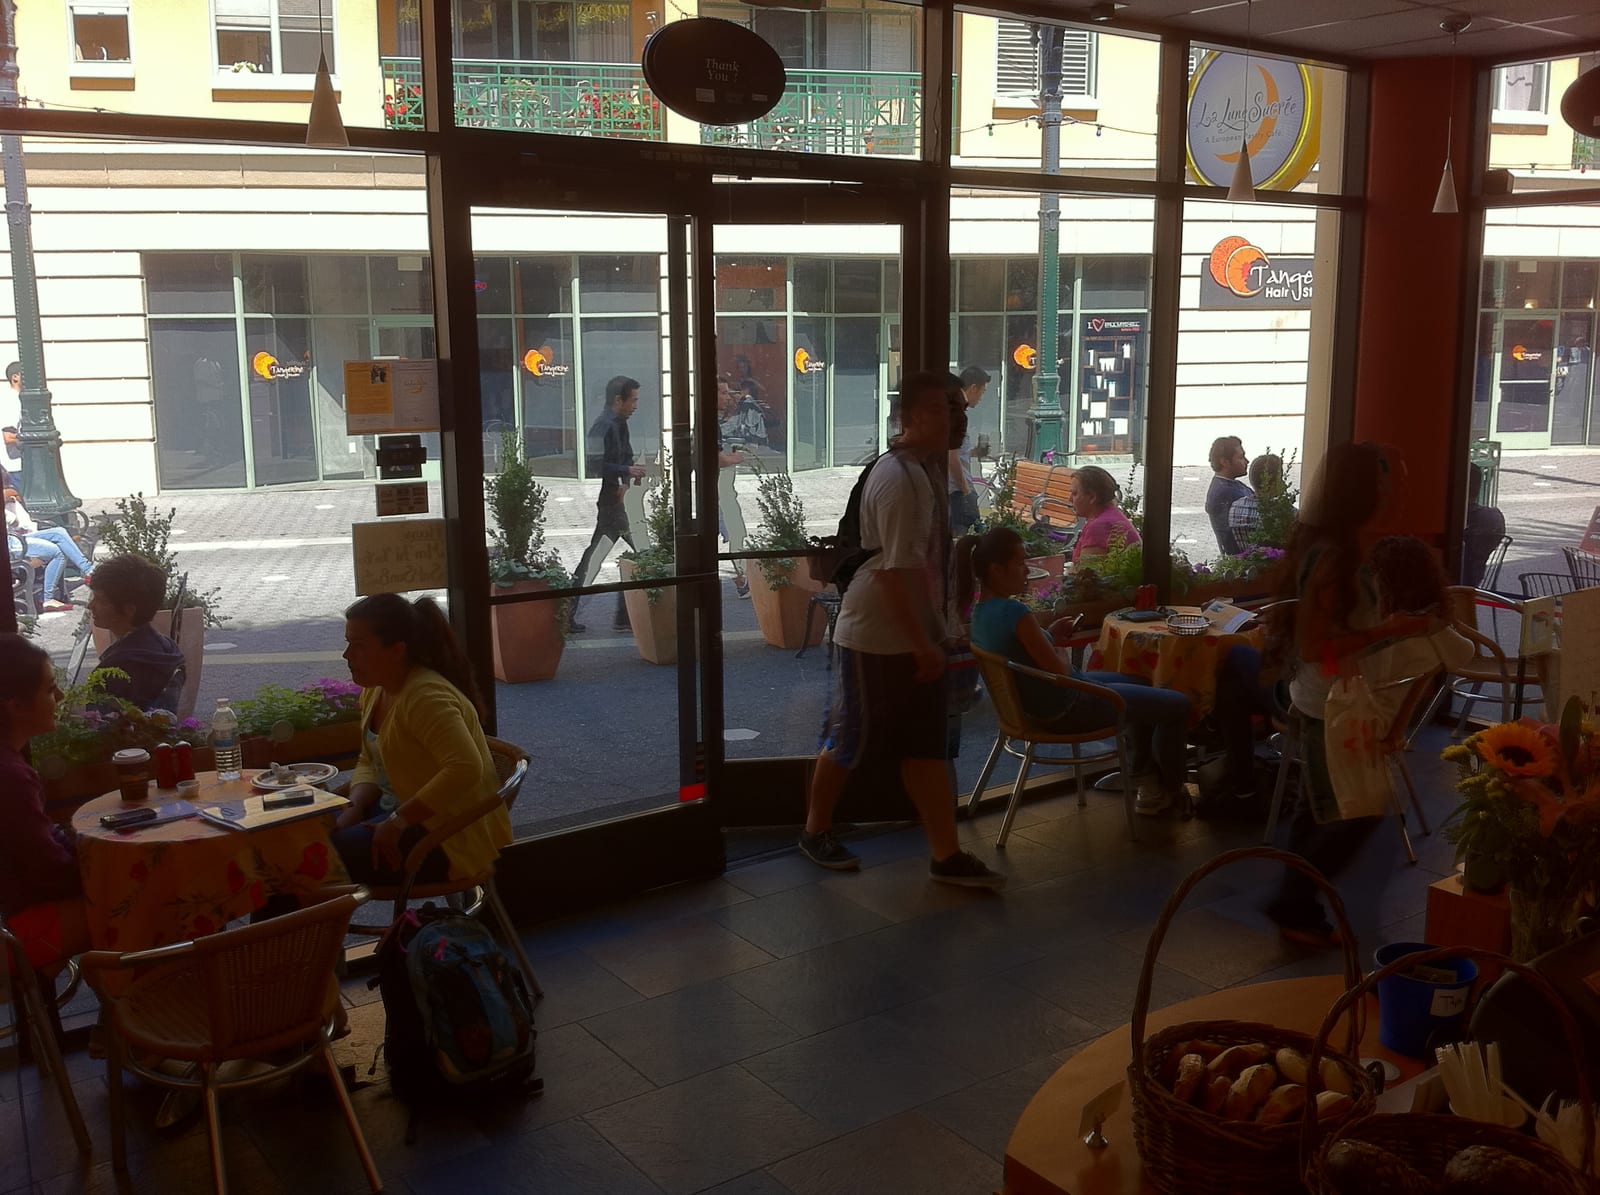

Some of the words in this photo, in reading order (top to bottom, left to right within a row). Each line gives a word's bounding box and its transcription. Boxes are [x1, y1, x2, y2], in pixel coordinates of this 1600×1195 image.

[705, 58, 740, 72] Thank
[707, 69, 729, 81] You
[1200, 102, 1217, 128] La
[1265, 286, 1289, 298] Hair
